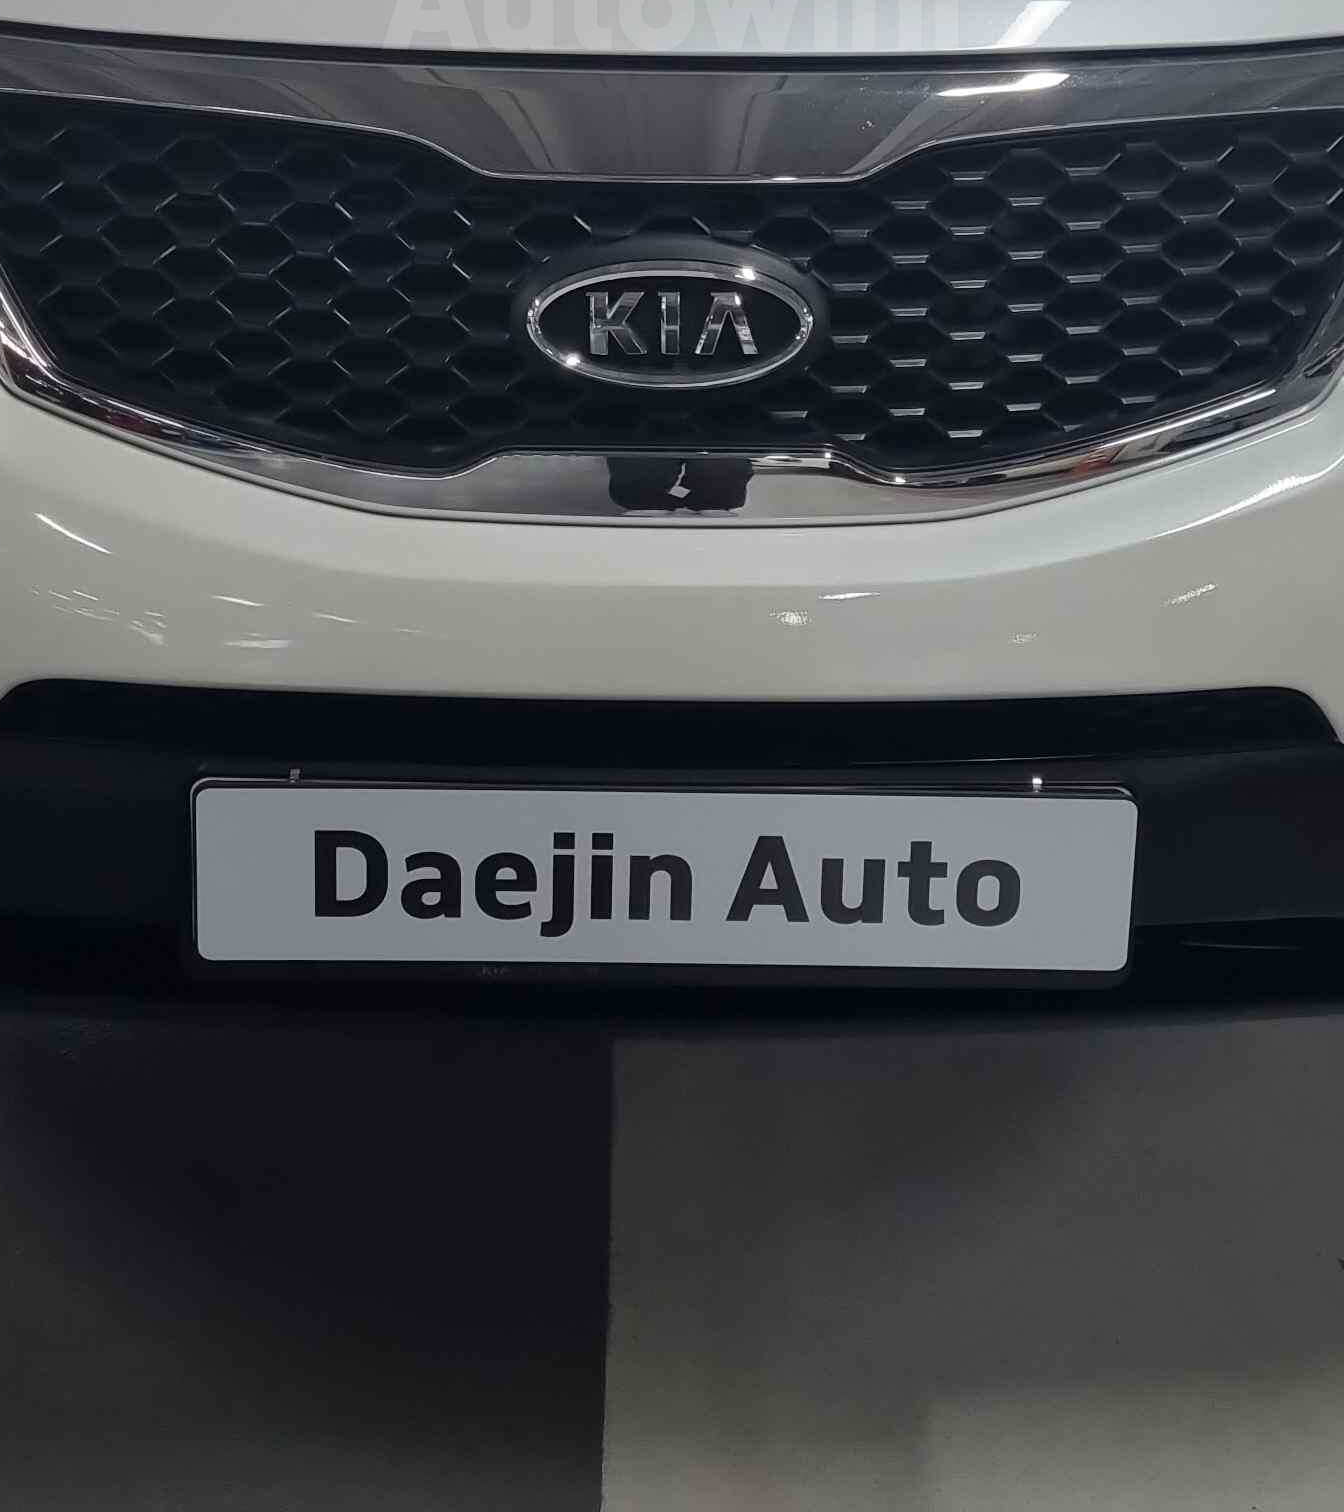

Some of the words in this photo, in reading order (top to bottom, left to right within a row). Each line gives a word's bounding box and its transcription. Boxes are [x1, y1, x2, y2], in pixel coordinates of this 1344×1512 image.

[586, 292, 759, 355] KIA
[314, 830, 694, 937] Daejin
[726, 835, 1022, 928] Auto
